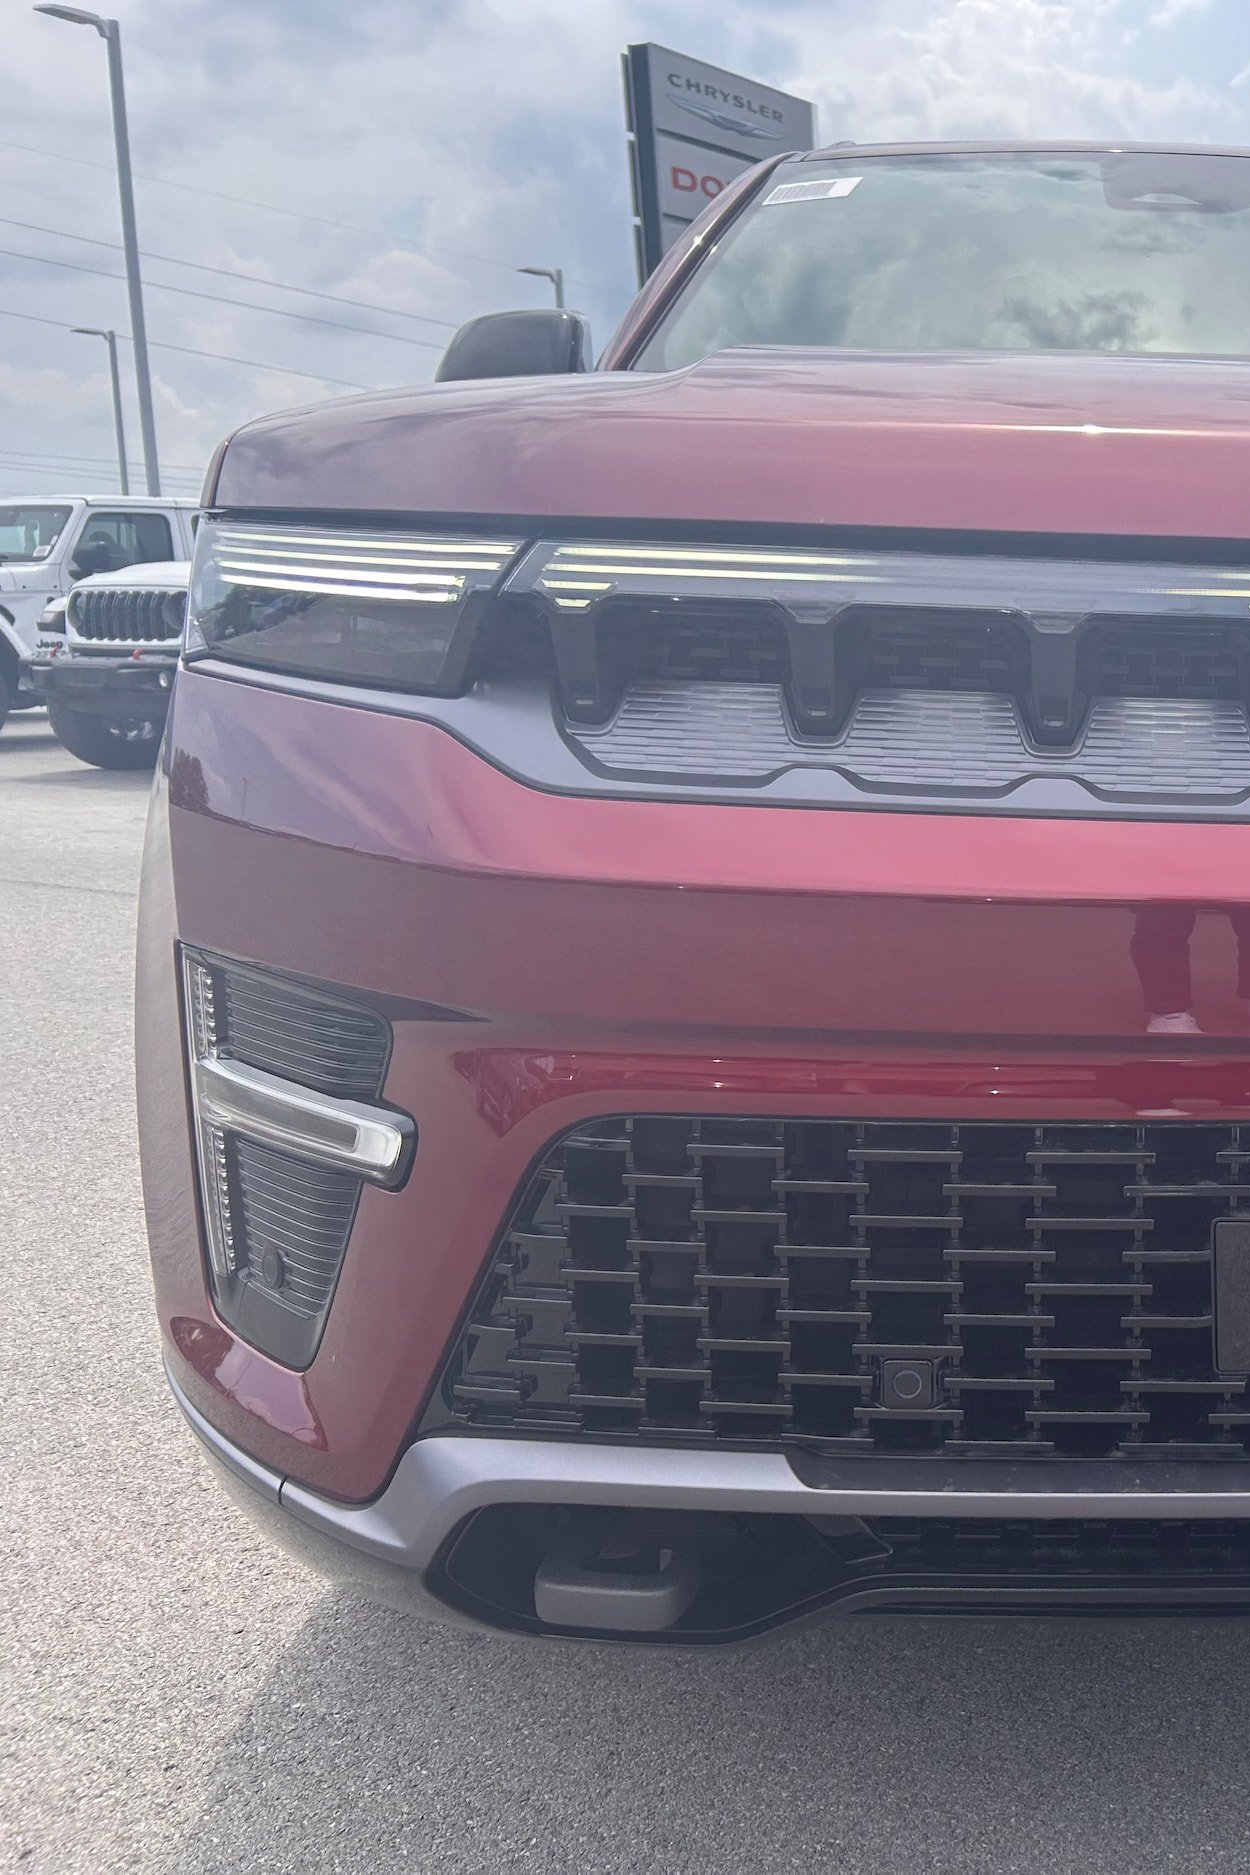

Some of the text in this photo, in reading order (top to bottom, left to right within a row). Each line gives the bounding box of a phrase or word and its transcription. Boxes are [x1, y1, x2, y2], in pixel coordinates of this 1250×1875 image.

[667, 73, 784, 123] CHRYSLER
[671, 166, 729, 200] DO
[36, 638, 64, 650] Jeep
